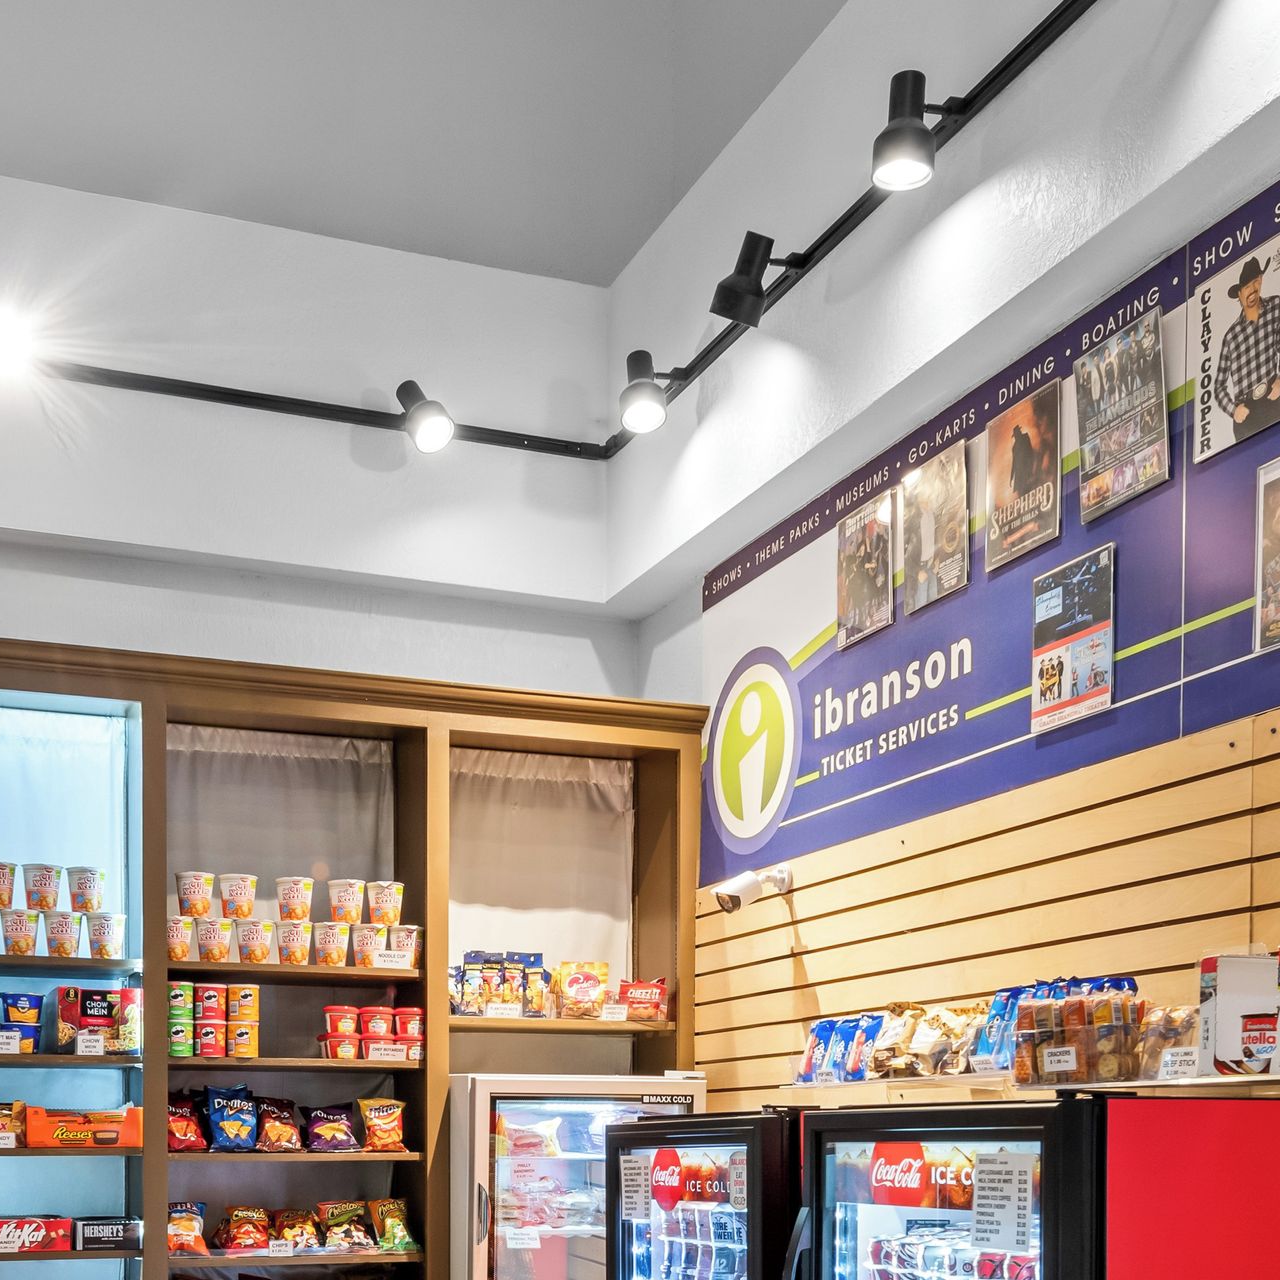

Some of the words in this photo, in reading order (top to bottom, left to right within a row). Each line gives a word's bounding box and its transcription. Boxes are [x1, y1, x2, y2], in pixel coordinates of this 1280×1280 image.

[1200, 288, 1211, 354] CLAY
[712, 565, 742, 594] SHOWS
[755, 536, 785, 566] THEME
[789, 512, 820, 543] PARKS
[836, 466, 889, 512] MUSEUMS
[908, 408, 976, 463] GO-KARTS
[998, 356, 1055, 405] DINING
[1082, 286, 1160, 350] BOATING
[1193, 222, 1253, 276] SHOW
[1200, 358, 1211, 454] COOPER
[990, 481, 1054, 540] SHEPHERD
[813, 637, 973, 740] ibranson
[821, 739, 874, 777] TICKET
[878, 704, 960, 756] SERVICES
[1178, 1059, 1197, 1068] STICK
[214, 1097, 254, 1112] Doritos
[649, 1095, 672, 1104] MAXX
[672, 1095, 692, 1104] COLD
[686, 1180, 702, 1193] ICE
[930, 1165, 957, 1186] ICE
[84, 1225, 124, 1238] HERSHEY'S
